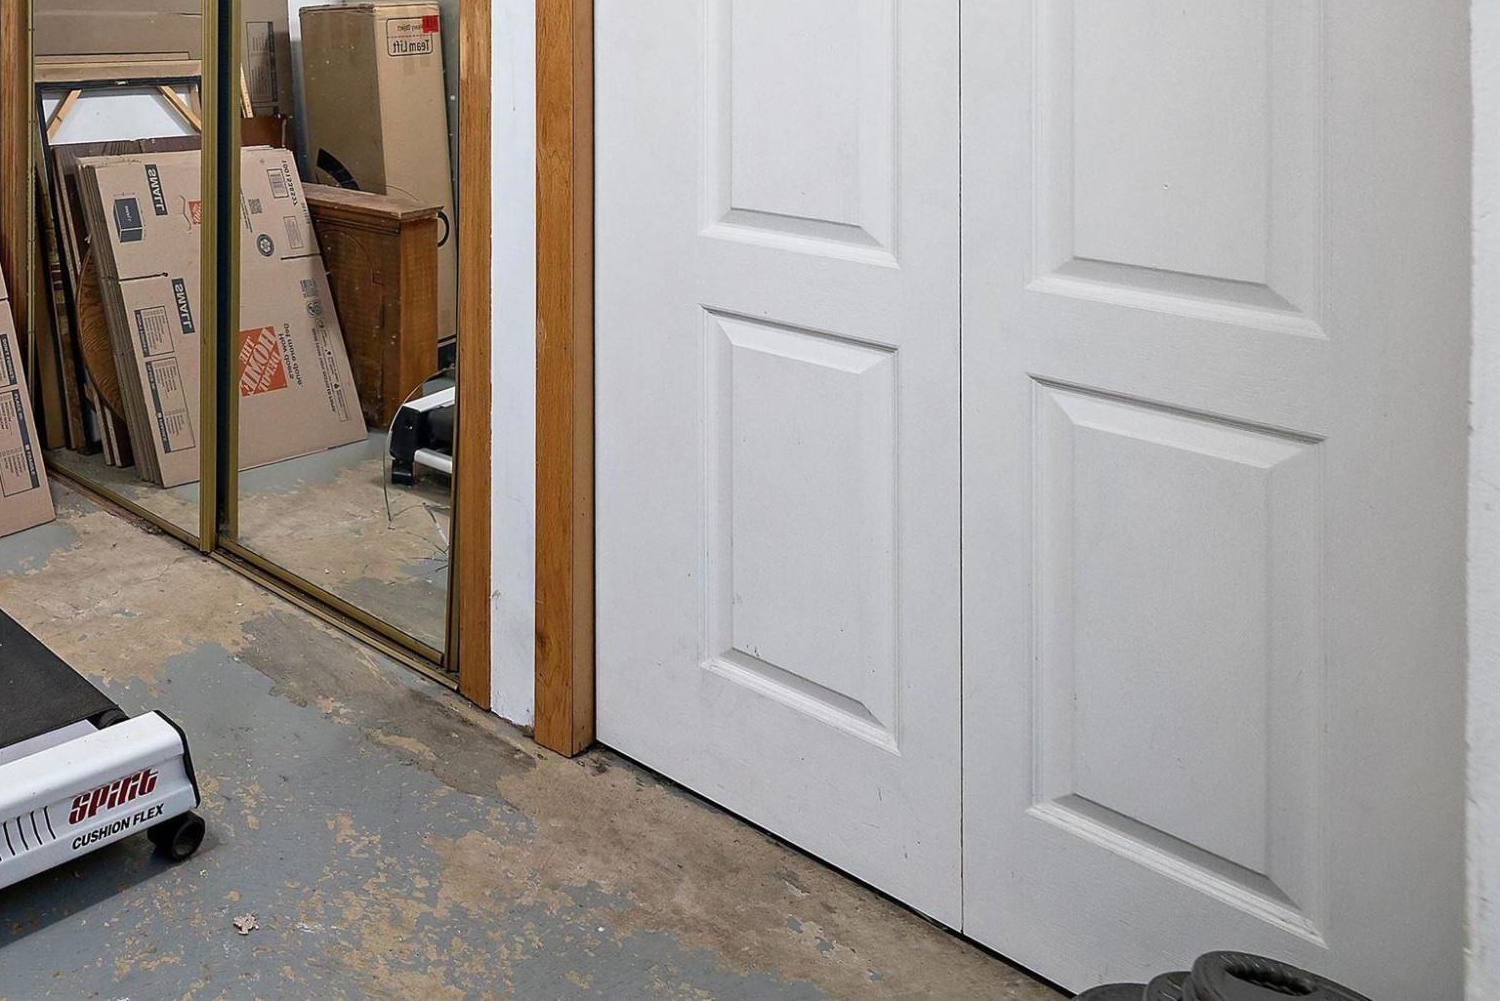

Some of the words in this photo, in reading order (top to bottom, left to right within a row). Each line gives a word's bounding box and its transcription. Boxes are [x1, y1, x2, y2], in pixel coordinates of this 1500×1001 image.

[26, 451, 35, 476] FRAGILE
[72, 817, 131, 850] CUSHION
[132, 803, 164, 826] FLEX
